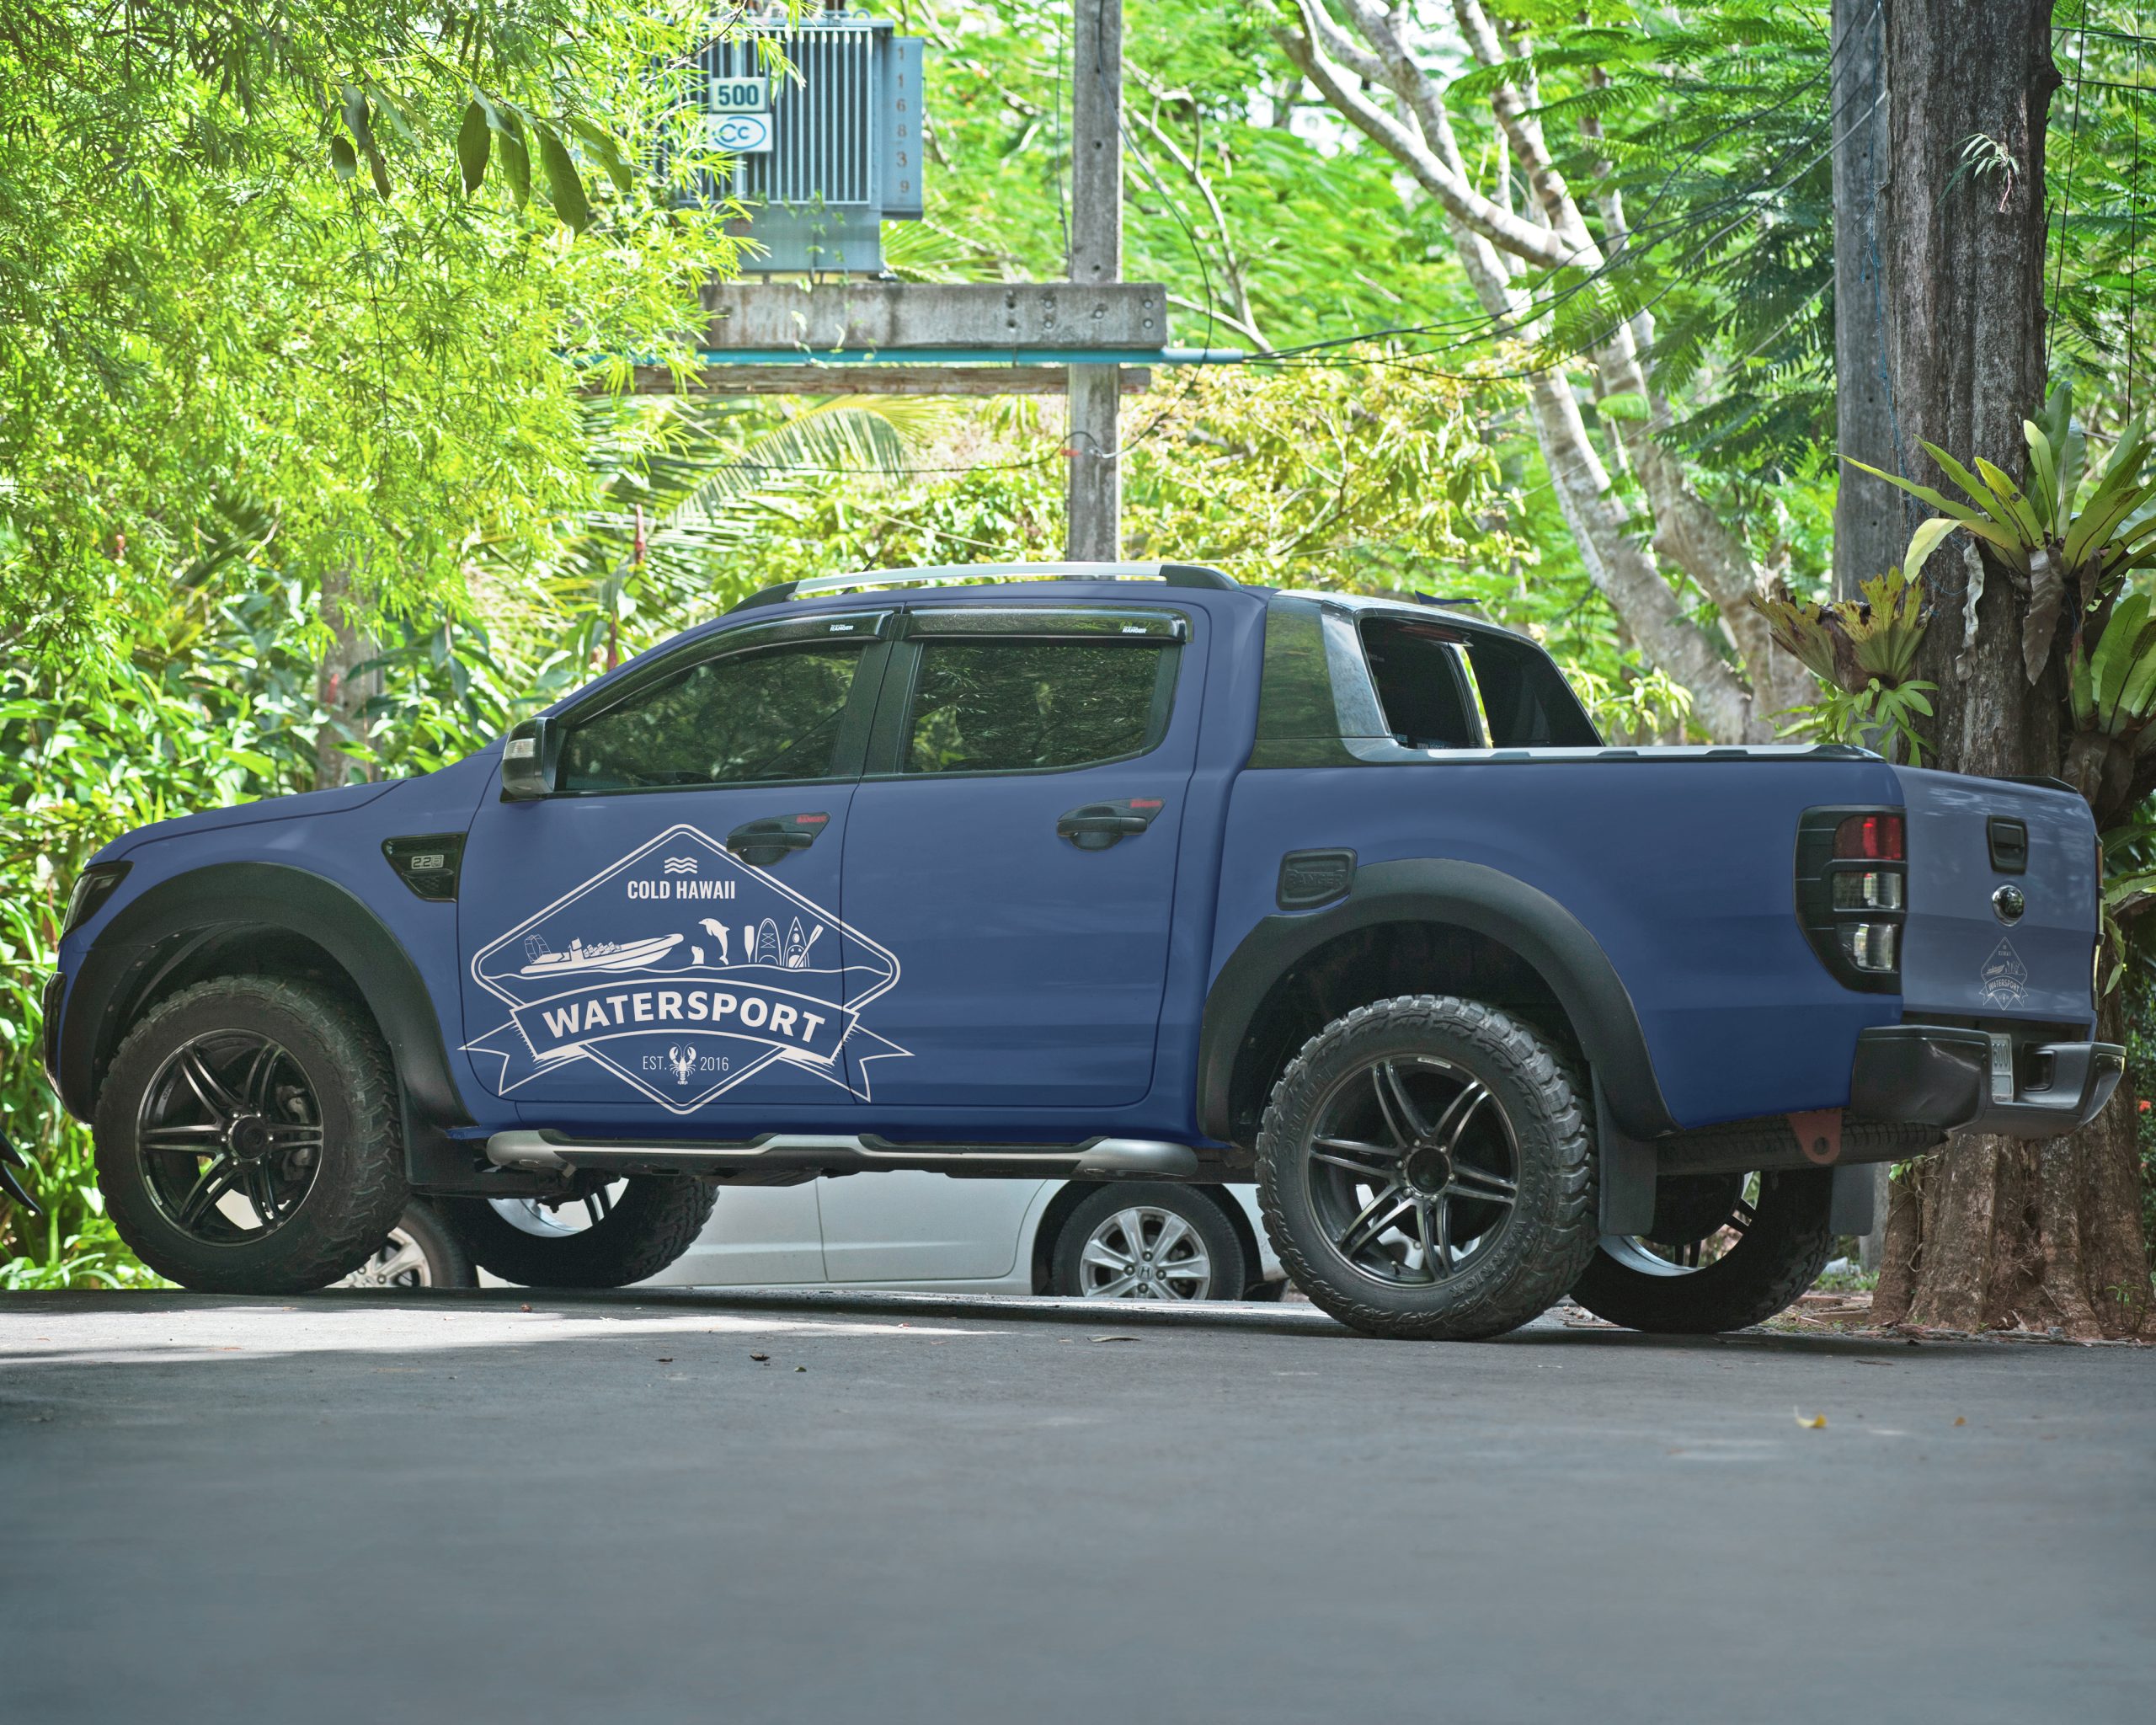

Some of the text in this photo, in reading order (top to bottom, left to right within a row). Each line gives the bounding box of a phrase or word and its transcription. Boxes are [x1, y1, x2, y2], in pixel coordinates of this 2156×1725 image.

[718, 85, 759, 105] 500
[628, 881, 734, 899] COLD HAWAII
[1286, 873, 1343, 889] RANGER
[1988, 979, 2020, 992] WATERSPORT
[542, 991, 825, 1042] WATERSPORT
[643, 1056, 729, 1071] EST. 2016
[1449, 1220, 1527, 1297] WARRIOR
